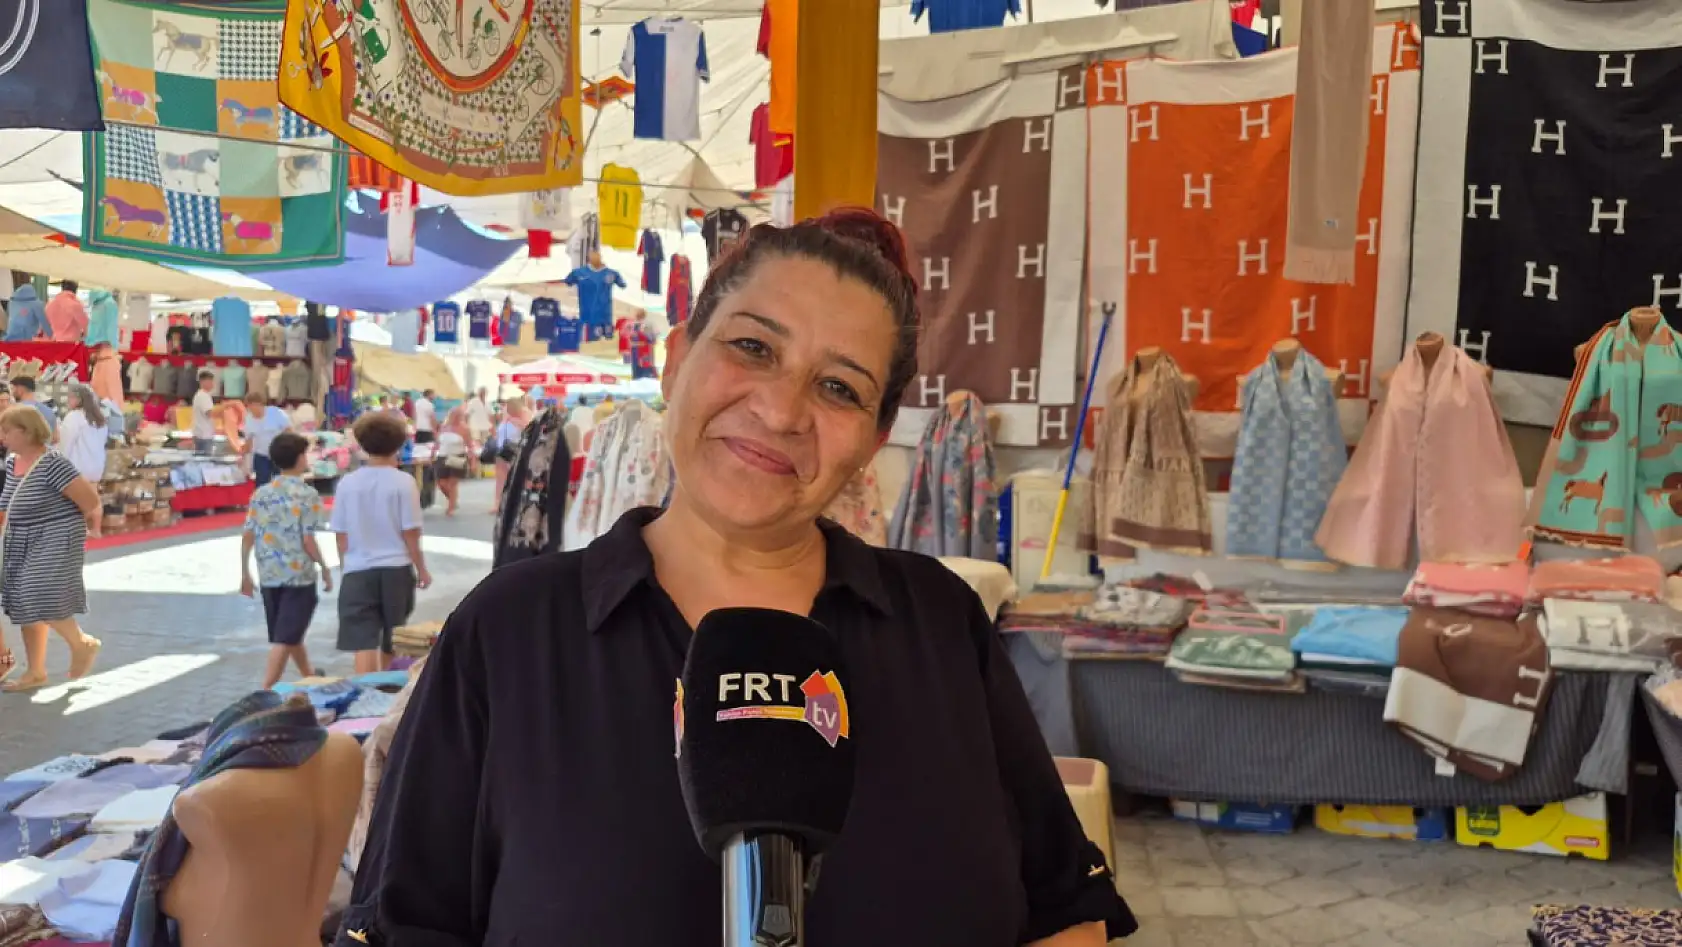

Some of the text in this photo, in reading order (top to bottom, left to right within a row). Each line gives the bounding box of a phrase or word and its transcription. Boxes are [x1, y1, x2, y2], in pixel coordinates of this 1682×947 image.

[1436, 0, 1467, 33] H
[1475, 41, 1509, 75] H
[1596, 54, 1634, 88] H
[1059, 71, 1085, 108] H
[1096, 68, 1126, 102] H
[1023, 118, 1051, 152] H
[1130, 106, 1159, 141] H
[1240, 105, 1270, 140] H
[1531, 119, 1567, 155] H
[929, 140, 955, 173] H
[613, 188, 629, 218] 11
[972, 185, 998, 223] H
[1183, 174, 1212, 208] H
[1467, 185, 1501, 220] H
[1589, 198, 1628, 235] H
[1016, 245, 1044, 278] H
[1129, 239, 1157, 273] H
[1238, 240, 1268, 275] H
[923, 257, 950, 291] H
[1523, 261, 1559, 301] H
[437, 313, 454, 332] 10
[968, 311, 995, 344] H
[1181, 309, 1212, 344] H
[1291, 296, 1316, 333] H
[920, 375, 945, 406] H
[1011, 368, 1038, 402] H
[1040, 409, 1067, 439] H
[719, 672, 796, 702] FRT
[813, 702, 837, 728] tv
